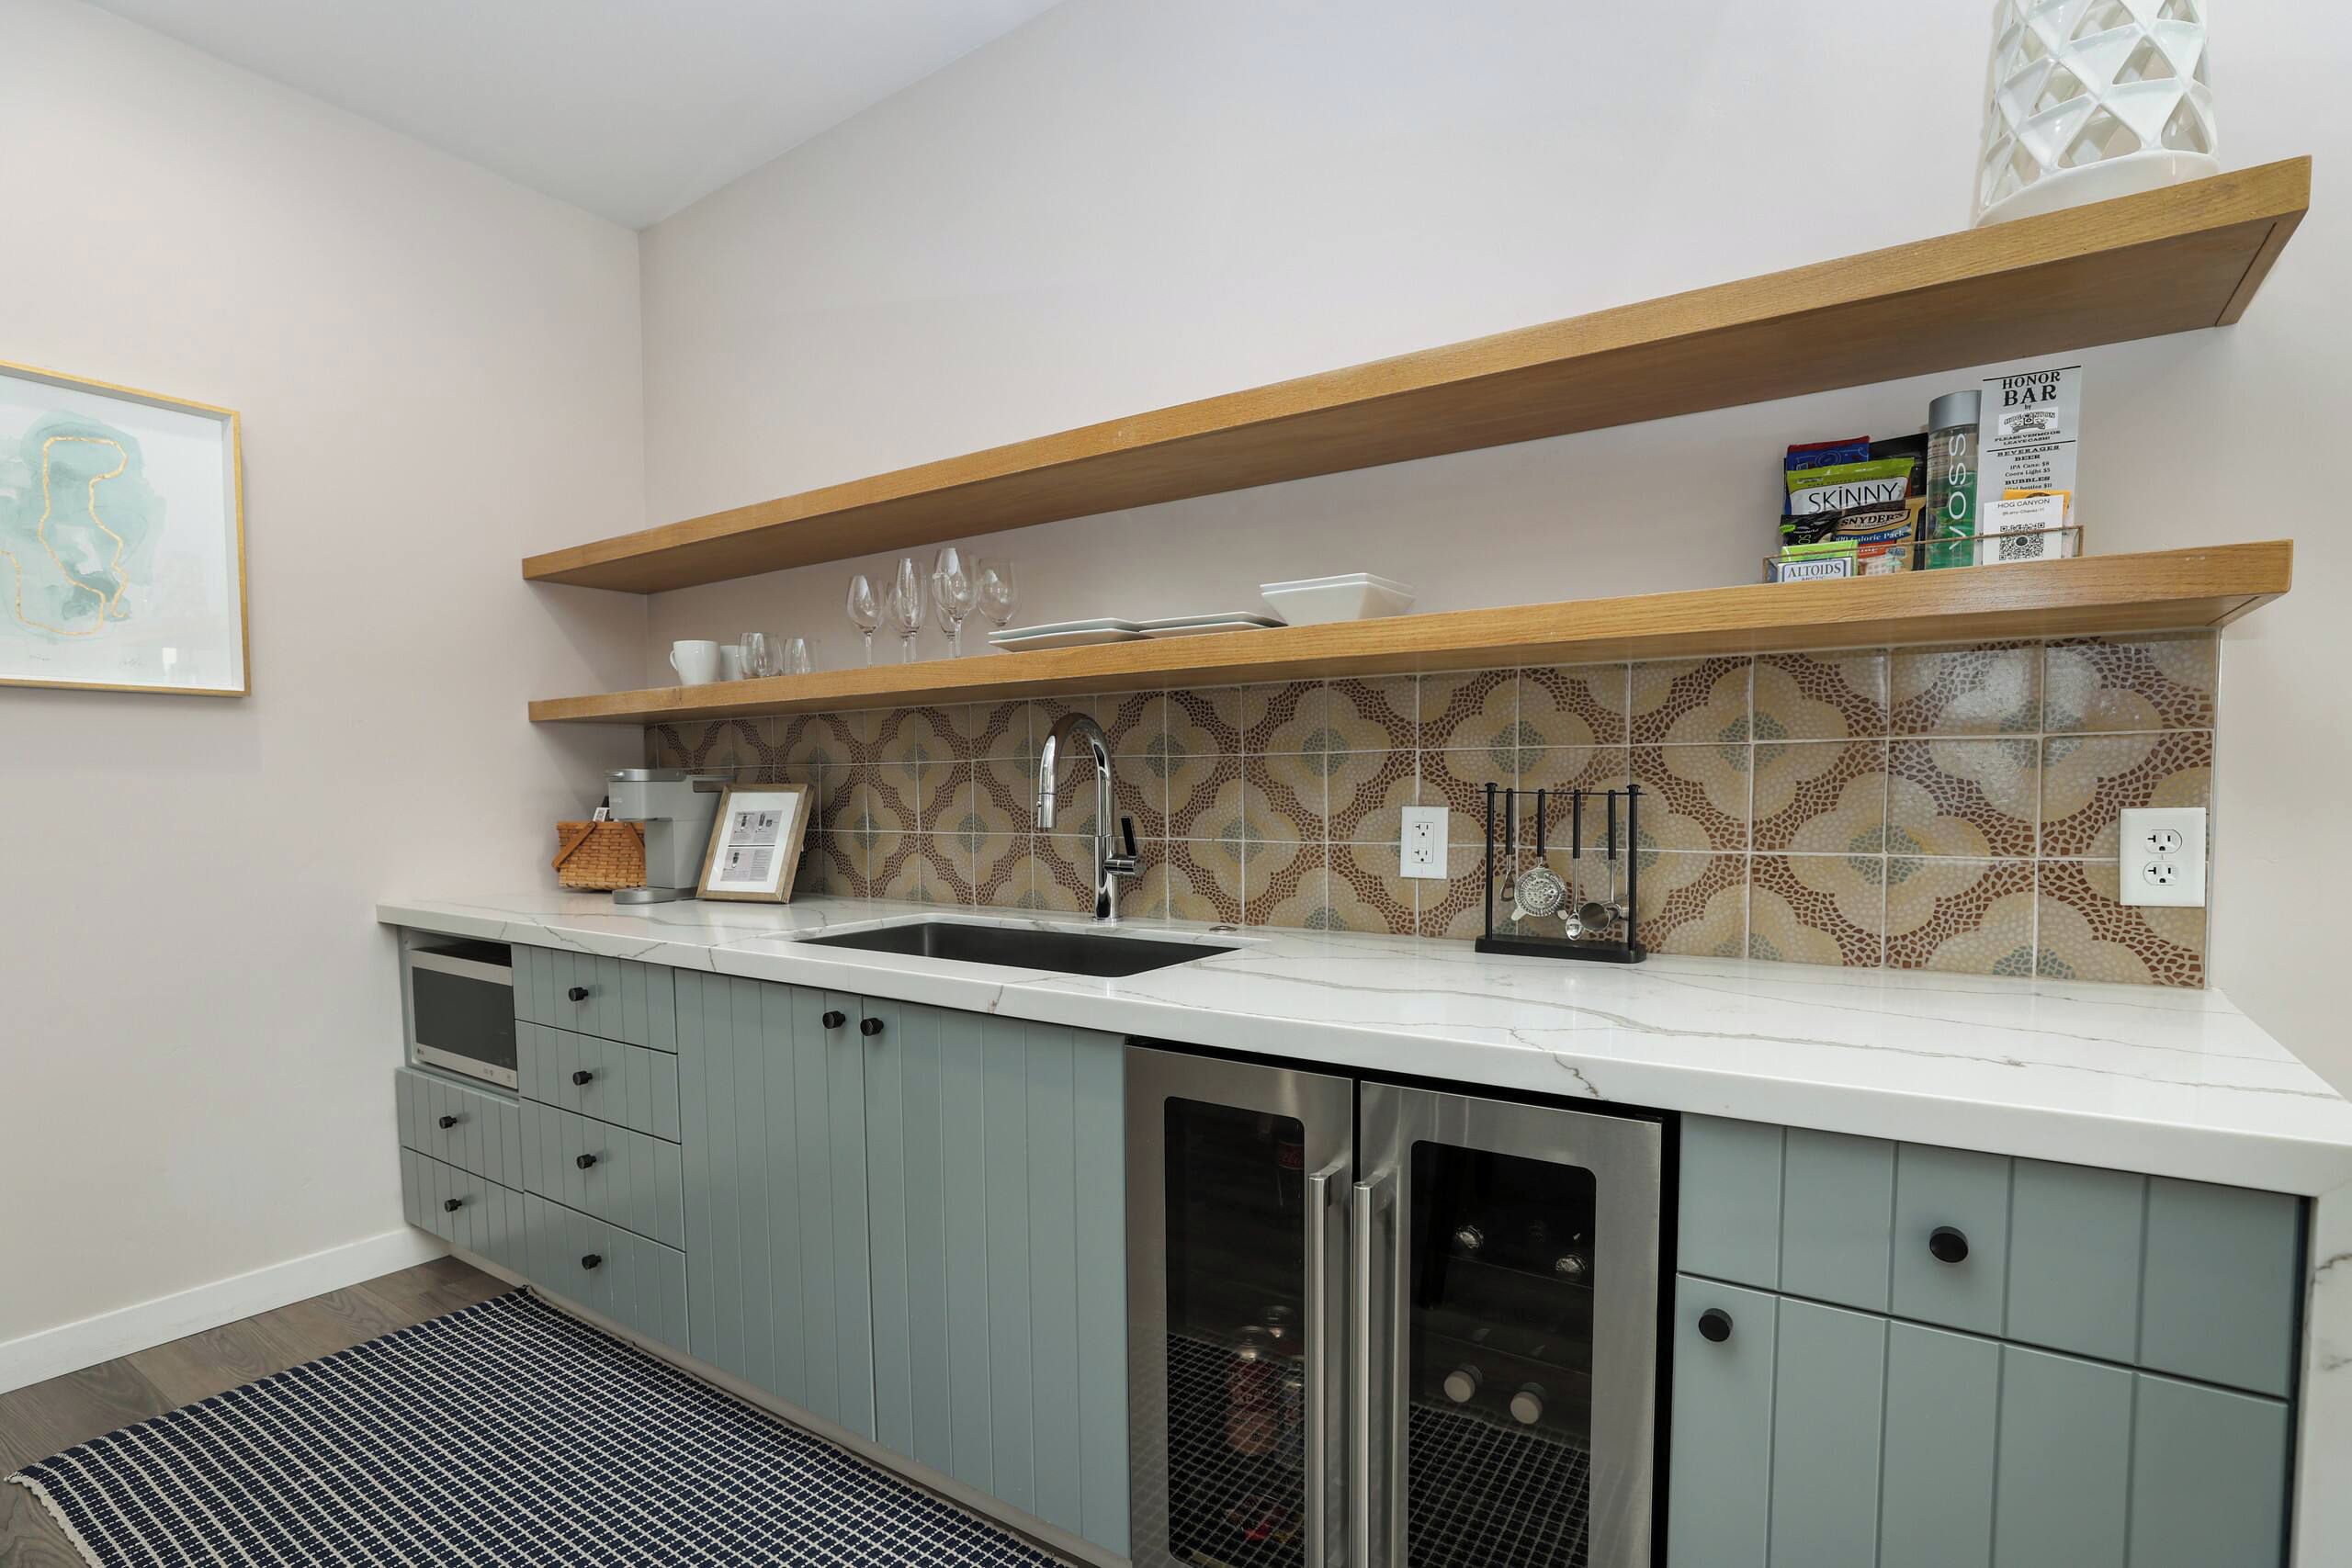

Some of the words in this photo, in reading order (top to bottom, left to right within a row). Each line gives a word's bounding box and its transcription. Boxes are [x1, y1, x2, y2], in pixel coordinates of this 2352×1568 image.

[2003, 371, 2061, 389] HONOR
[2004, 384, 2057, 407] BAR
[1996, 445, 2060, 457] BEVERAGES
[2015, 454, 2041, 462] BEER
[2005, 476, 2051, 485] BUBBLES
[1949, 433, 1966, 550] VOSS
[1997, 501, 2015, 509] HOG
[2017, 498, 2050, 507] CANYON
[1883, 530, 1905, 539] Pack
[1788, 562, 1841, 578] ALTOIDS
